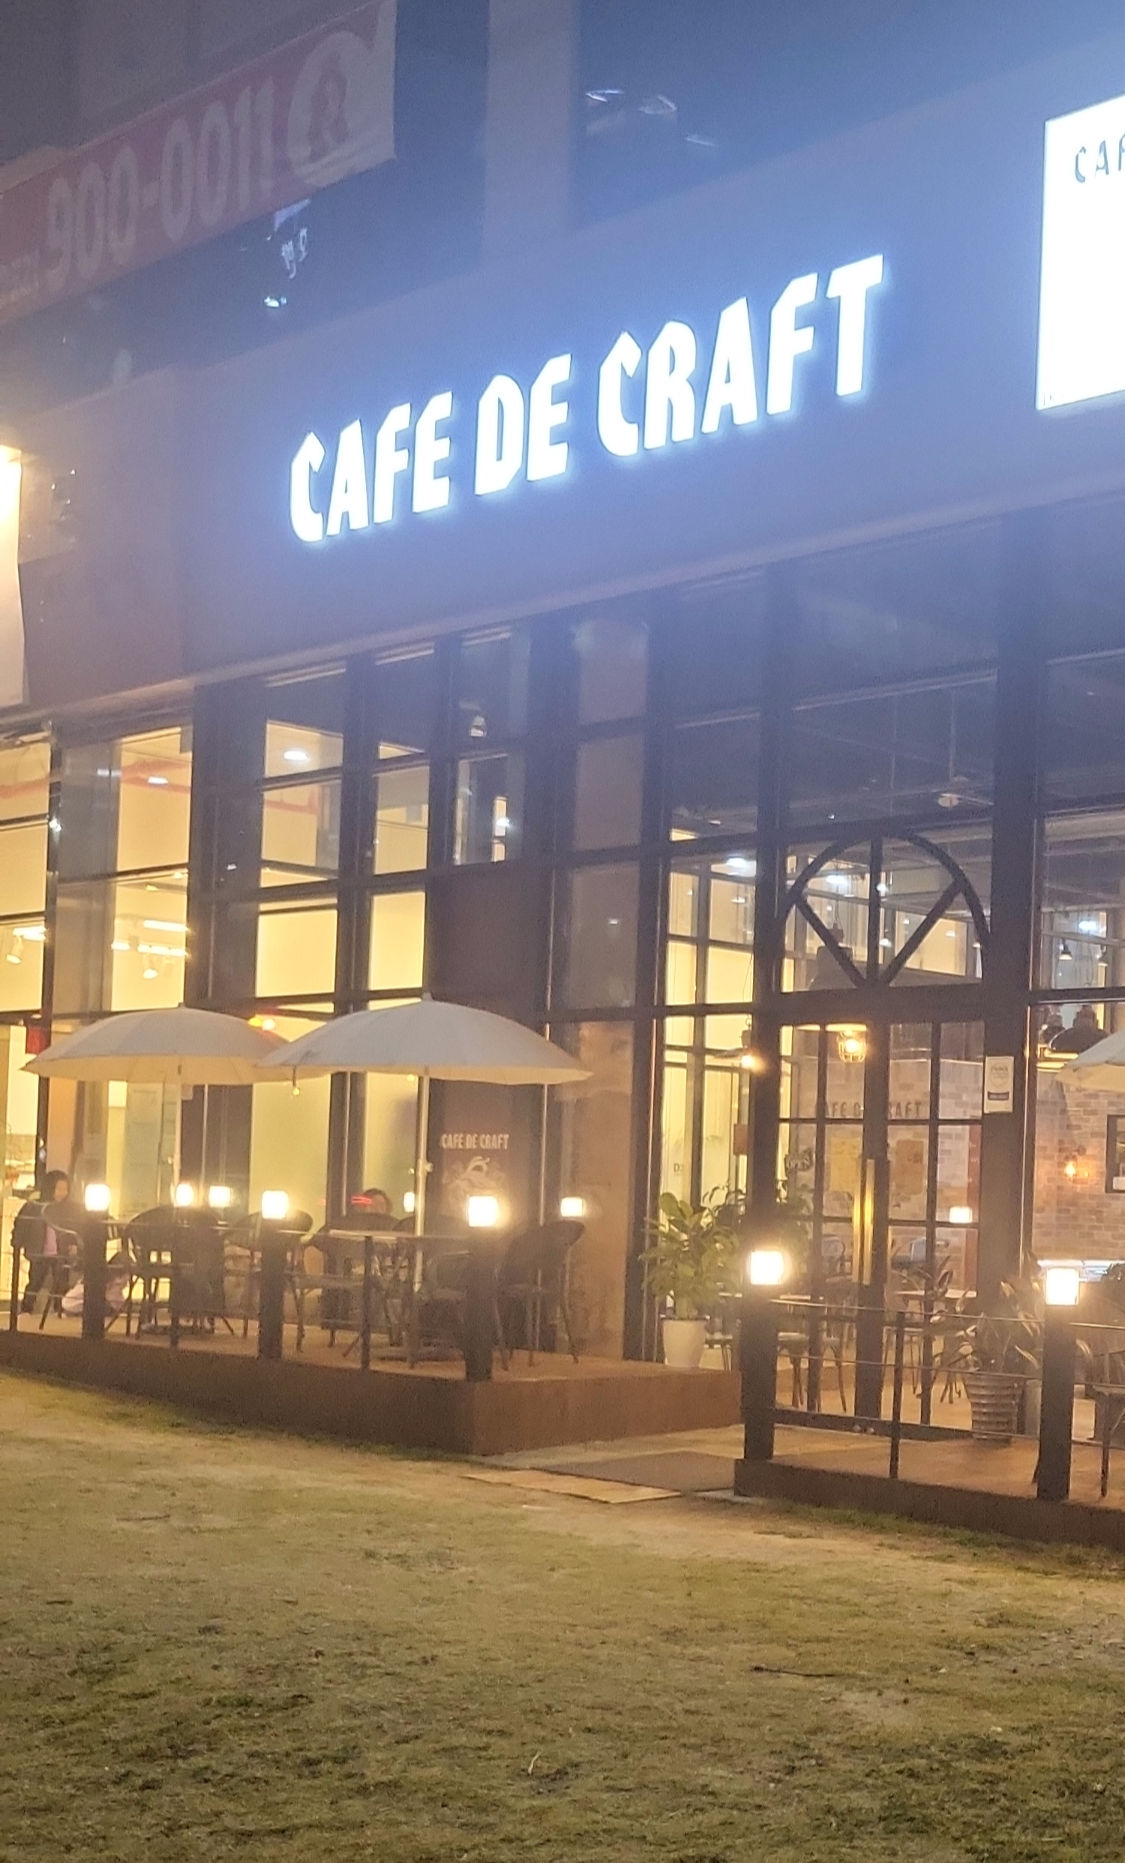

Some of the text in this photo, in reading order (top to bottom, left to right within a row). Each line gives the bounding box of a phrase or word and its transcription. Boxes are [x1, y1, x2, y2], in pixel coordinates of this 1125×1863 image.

[290, 254, 884, 542] CAFE DE CRAFT
[442, 1133, 509, 1150] CAFE DE CRAFT
